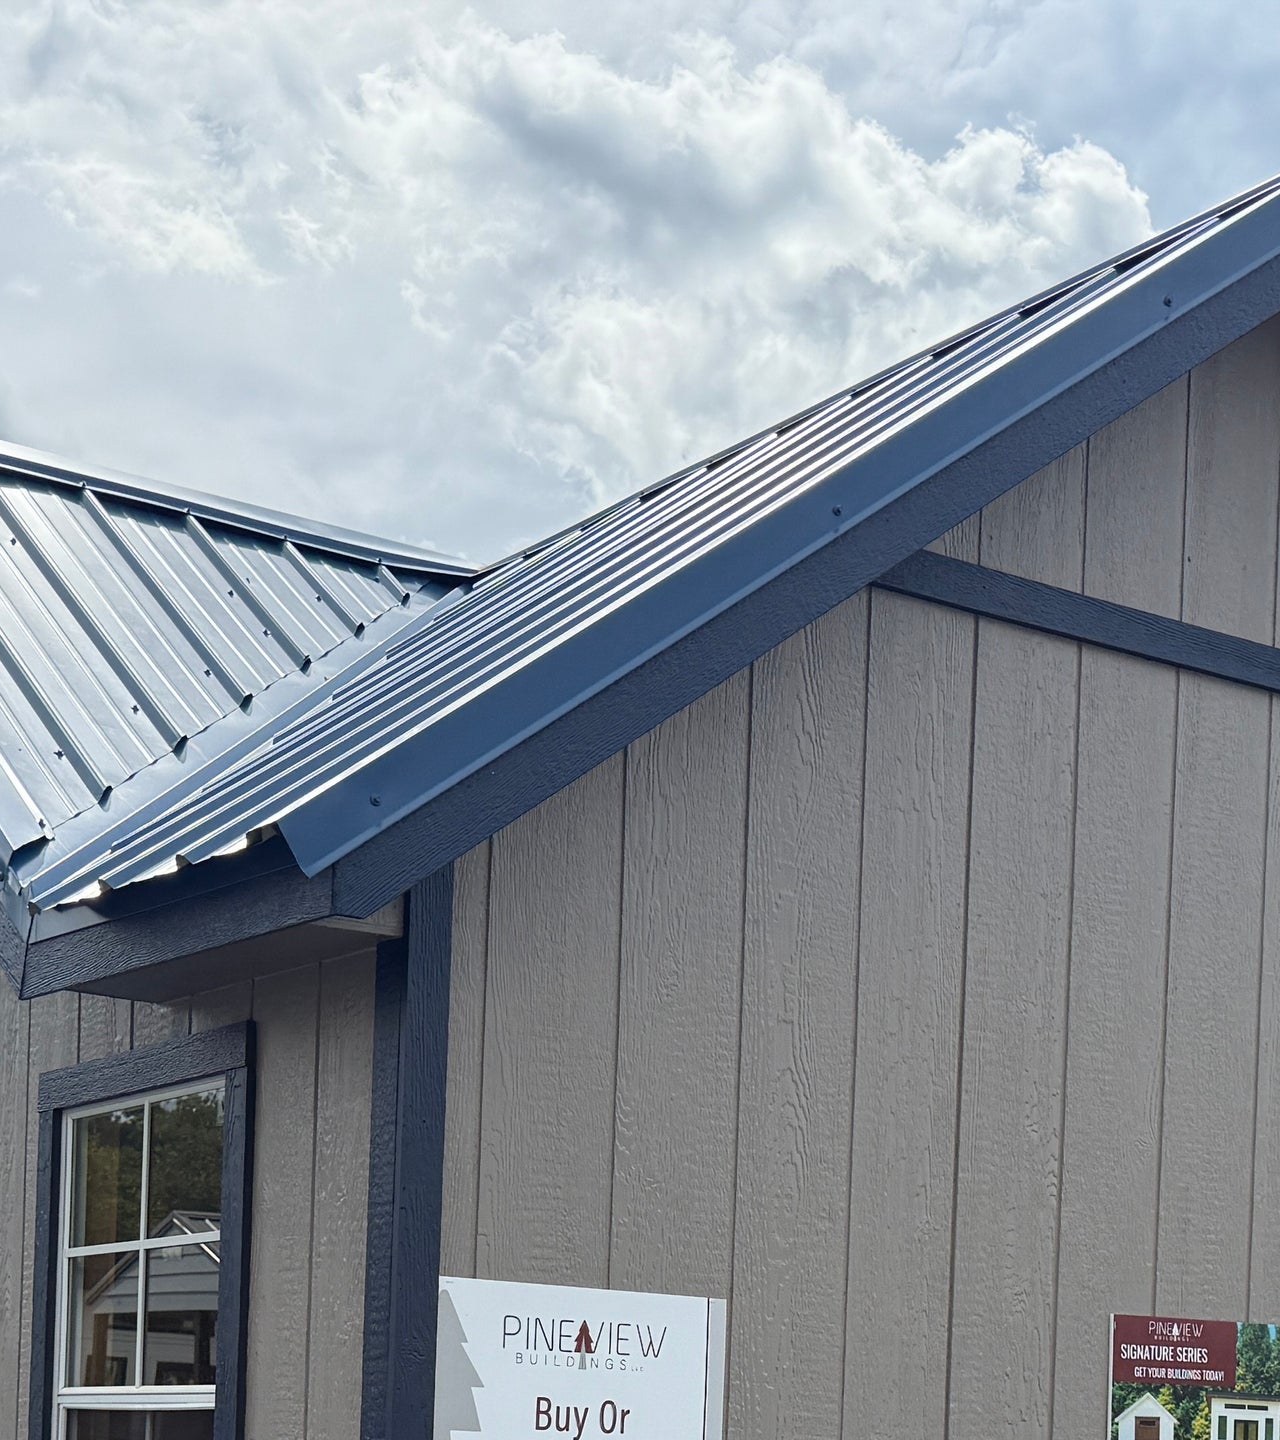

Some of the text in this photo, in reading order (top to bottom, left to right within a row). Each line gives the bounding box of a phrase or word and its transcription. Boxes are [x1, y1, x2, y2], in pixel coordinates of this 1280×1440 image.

[1120, 1343, 1209, 1364] SIGNATURE SERIES
[1134, 1366, 1225, 1382] GET YOUR BUILDINGS TODAY!
[599, 1399, 631, 1435] Or
